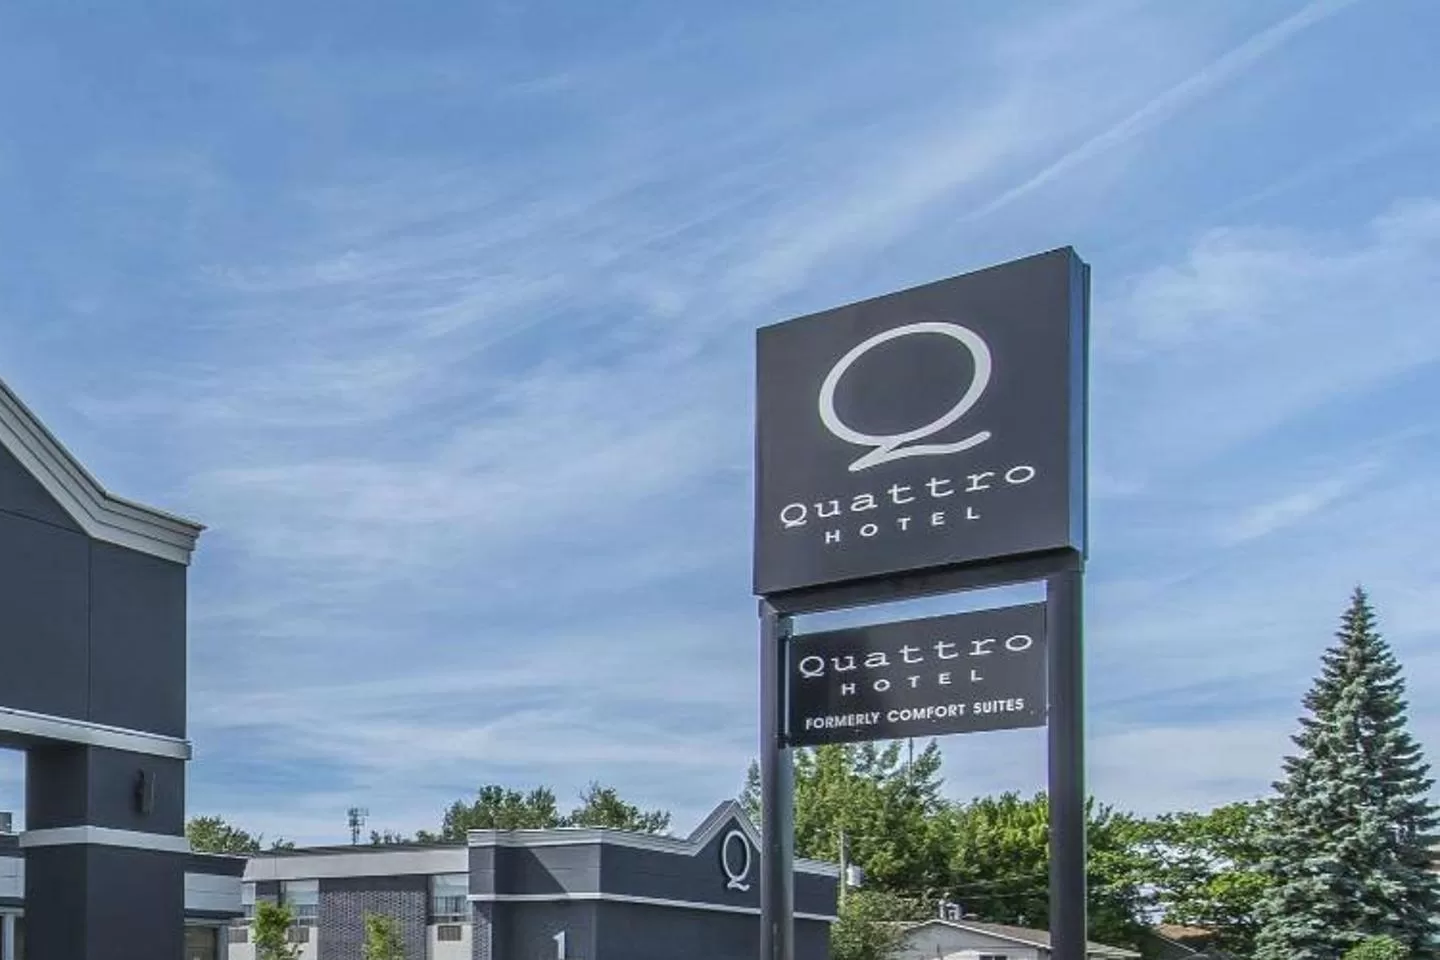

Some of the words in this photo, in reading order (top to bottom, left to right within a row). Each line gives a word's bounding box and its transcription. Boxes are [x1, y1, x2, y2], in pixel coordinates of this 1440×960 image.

[818, 321, 992, 472] Q
[780, 465, 1036, 529] Quattro
[824, 506, 981, 544] HOTEL
[799, 634, 1033, 679] Quattro
[841, 669, 984, 697] HOTEL
[805, 711, 880, 731] FORMERLY
[886, 703, 966, 723] COMFORT
[972, 698, 1025, 715] SUITES
[722, 830, 751, 892] Q
[553, 929, 566, 960] 1
